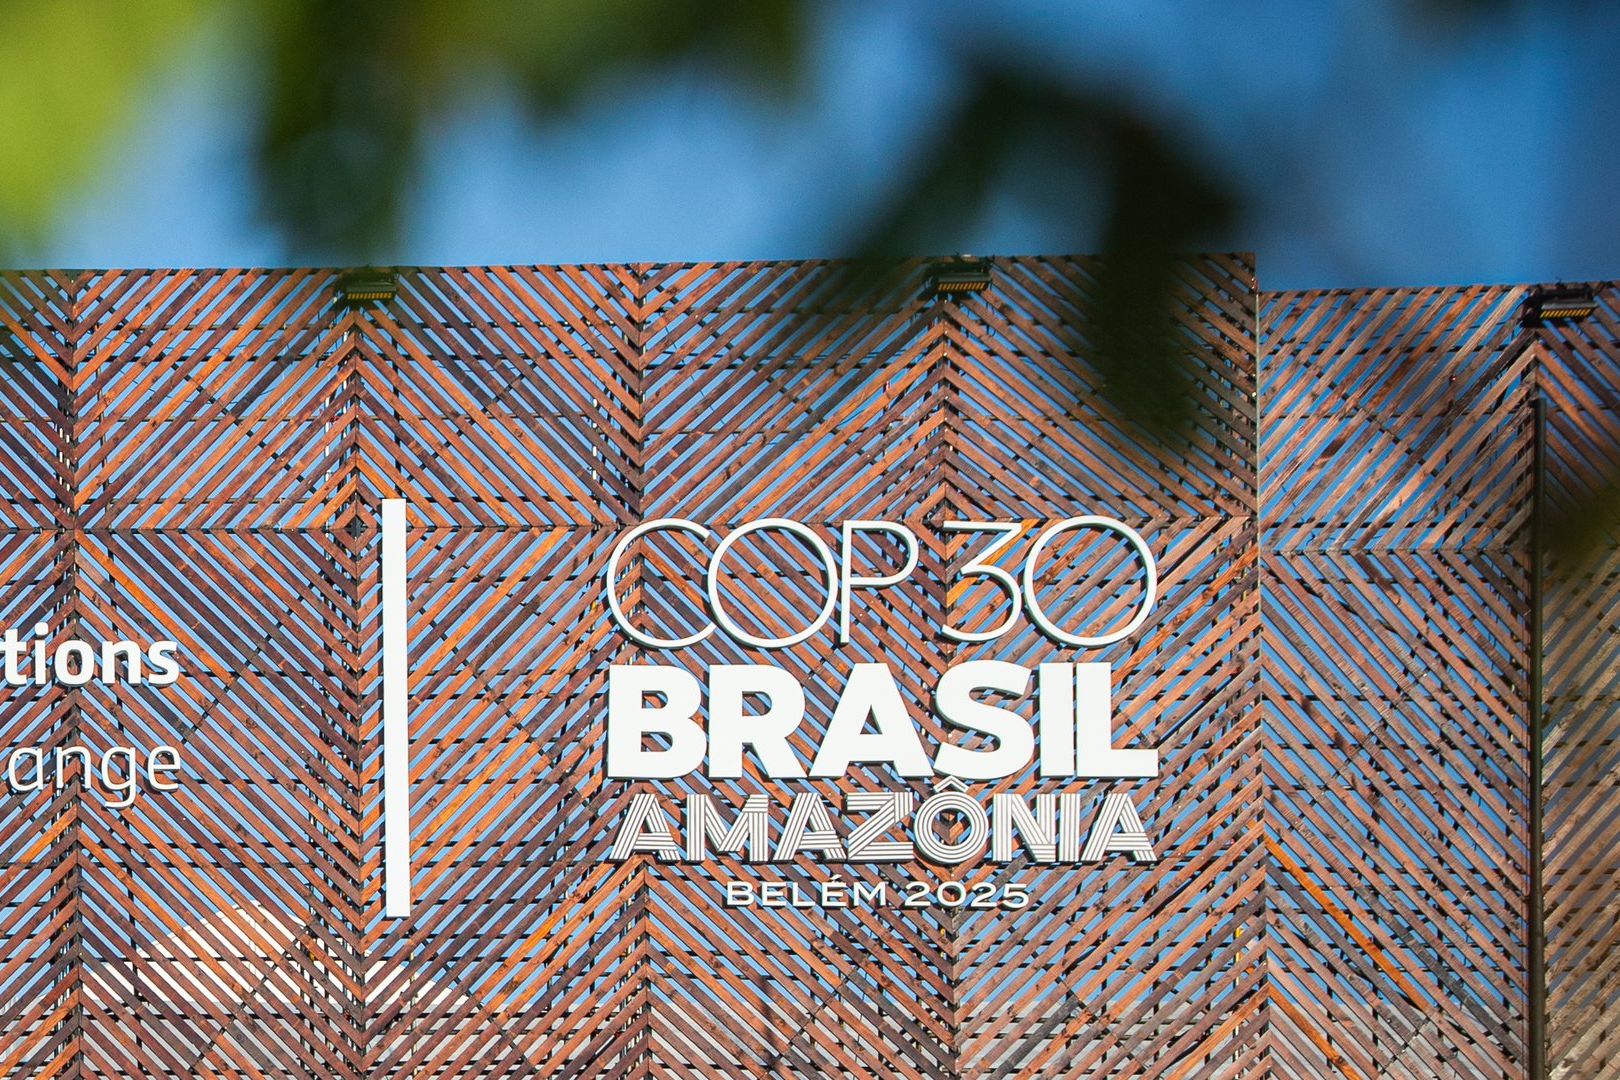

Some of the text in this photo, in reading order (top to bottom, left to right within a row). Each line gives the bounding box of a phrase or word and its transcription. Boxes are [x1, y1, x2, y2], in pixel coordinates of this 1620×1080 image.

[606, 515, 1157, 648] COP 30
[608, 659, 1158, 779] BRASIL
[608, 775, 1157, 863] AMAZÔNIA
[726, 874, 1029, 909] BELÉM 2025
